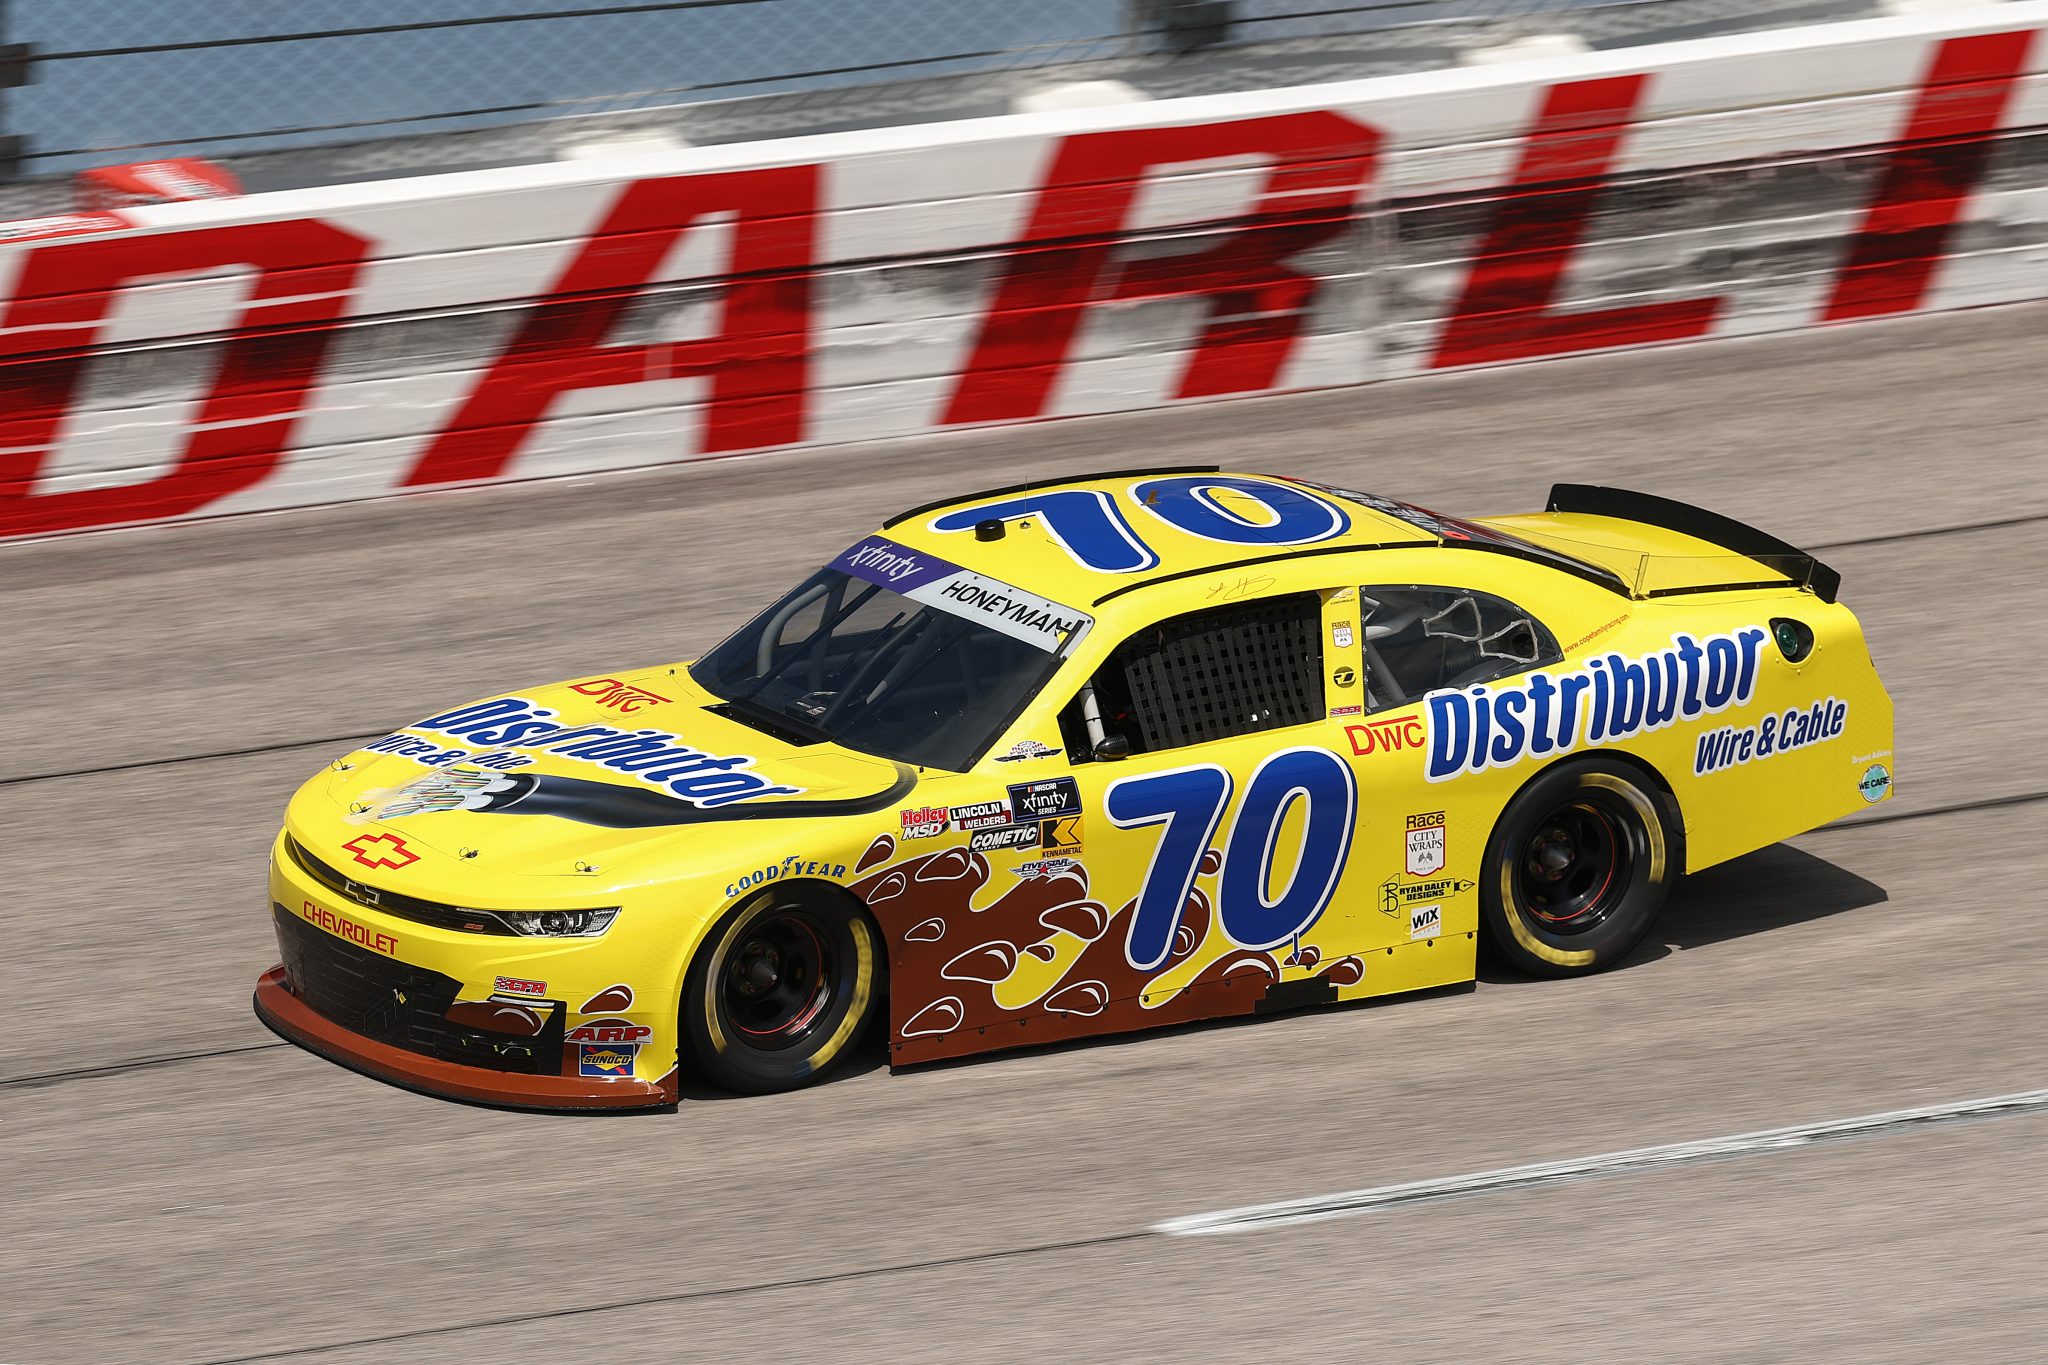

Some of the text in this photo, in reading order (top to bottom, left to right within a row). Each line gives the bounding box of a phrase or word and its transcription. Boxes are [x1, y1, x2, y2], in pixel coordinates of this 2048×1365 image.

[926, 476, 1352, 574] 70
[847, 543, 925, 582] xfinity
[568, 678, 674, 713] DWC
[1428, 629, 1766, 778] Distributor
[1343, 714, 1426, 757] DWC
[1695, 699, 1846, 774] Wire & Cable
[366, 733, 438, 756] Wire
[417, 750, 467, 766] &
[411, 698, 801, 806] Distributor
[1034, 782, 1057, 793] NASCAR
[1858, 776, 1891, 791] WE CARE
[1022, 790, 1068, 813] xfinity
[901, 806, 949, 828] Holley
[951, 802, 1001, 820] LINCOLN
[1037, 806, 1057, 816] SERIES
[1406, 811, 1446, 829] Race
[963, 814, 1007, 829] WELDERS
[902, 822, 943, 840] MSD
[971, 826, 1037, 849] COMETIC
[1413, 830, 1437, 842] CITY
[1041, 846, 1083, 858] KENNAMETAL
[1408, 838, 1443, 853] WRAPS
[1021, 861, 1043, 872] FIVE
[1046, 858, 1070, 867] STAR
[1103, 746, 1358, 973] 70
[1399, 881, 1452, 895] RYAN DALEY
[1406, 888, 1445, 901] DESIGNS
[1412, 906, 1439, 929] WIX
[303, 900, 399, 956] CHEVROLET
[567, 1026, 651, 1042] ARP
[583, 1054, 632, 1065] SUNOCO
